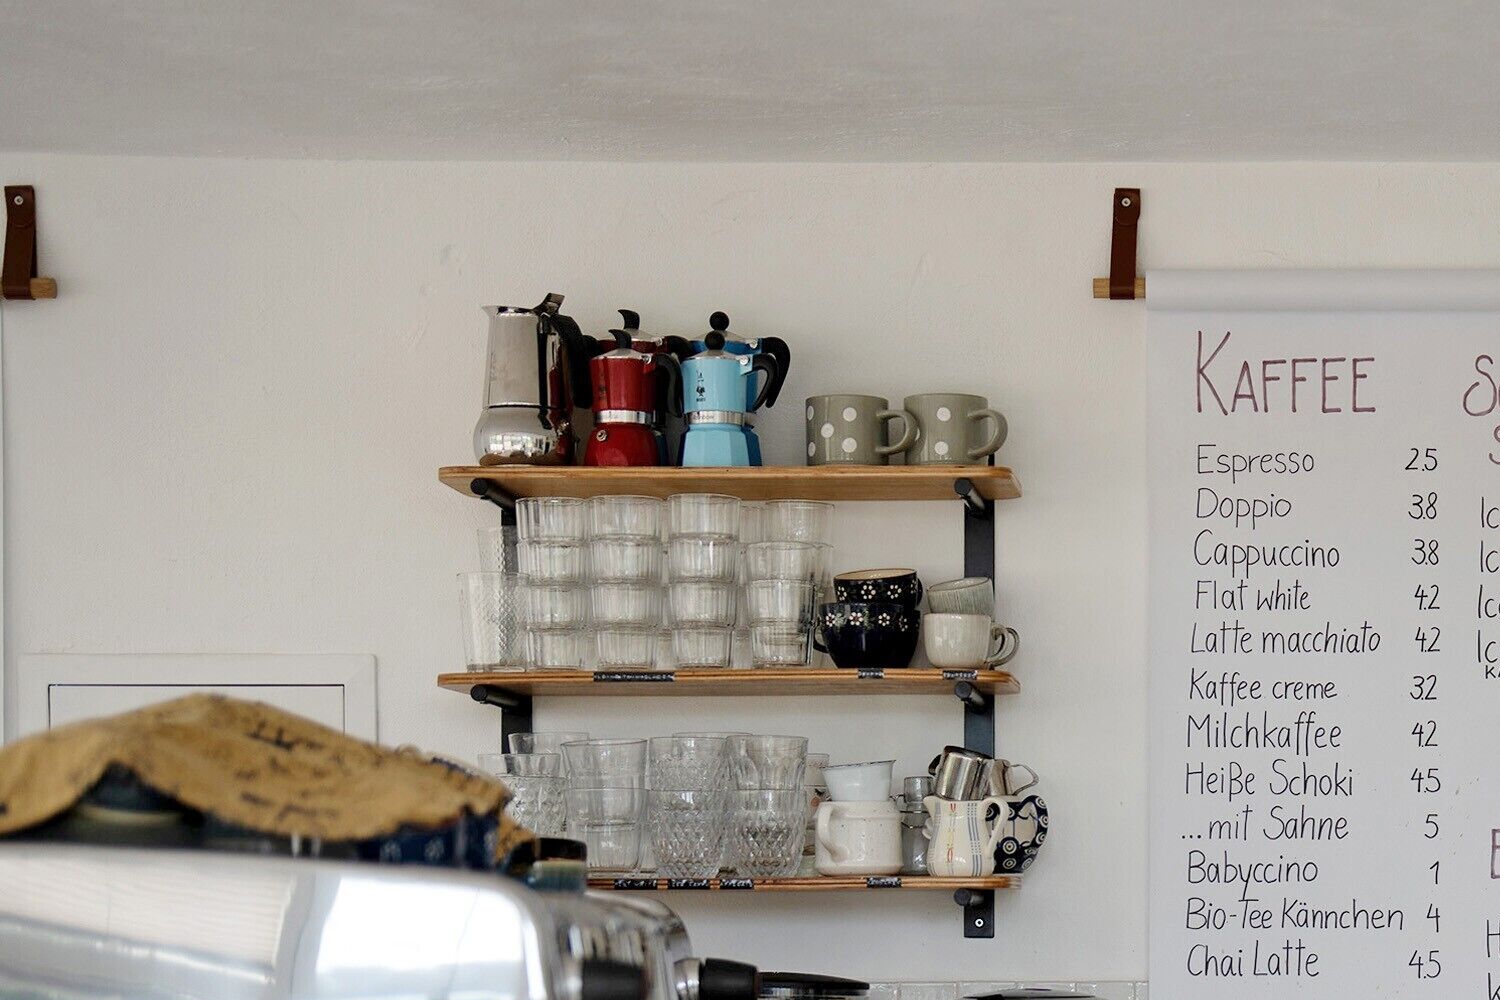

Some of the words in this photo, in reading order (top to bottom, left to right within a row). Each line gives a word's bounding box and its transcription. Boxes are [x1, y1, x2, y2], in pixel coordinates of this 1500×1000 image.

[1197, 330, 1377, 416] KAFFEE
[1197, 444, 1315, 484] Espresso
[1196, 487, 1293, 530] Doppio
[1193, 529, 1340, 579] Cappuccino
[1195, 579, 1248, 611] Flat
[1256, 579, 1312, 612] white
[1191, 620, 1254, 654] Latte
[1262, 620, 1382, 654] macchiato
[1188, 667, 1263, 707] Kaffee
[1271, 679, 1338, 701] creme
[1187, 710, 1343, 757] Milchkaffee
[1184, 760, 1256, 802] Heiße
[1268, 758, 1354, 798] Schoki
[1263, 805, 1350, 841] Sahne
[1424, 813, 1440, 840] 5
[1187, 849, 1320, 901] Babyccino
[1427, 861, 1440, 886] 1
[1185, 897, 1274, 930] Bio-Tee
[1281, 897, 1404, 931] Kännchen
[1426, 903, 1441, 934] 4
[1186, 943, 1244, 978] Chai
[1253, 938, 1321, 978] Latte
